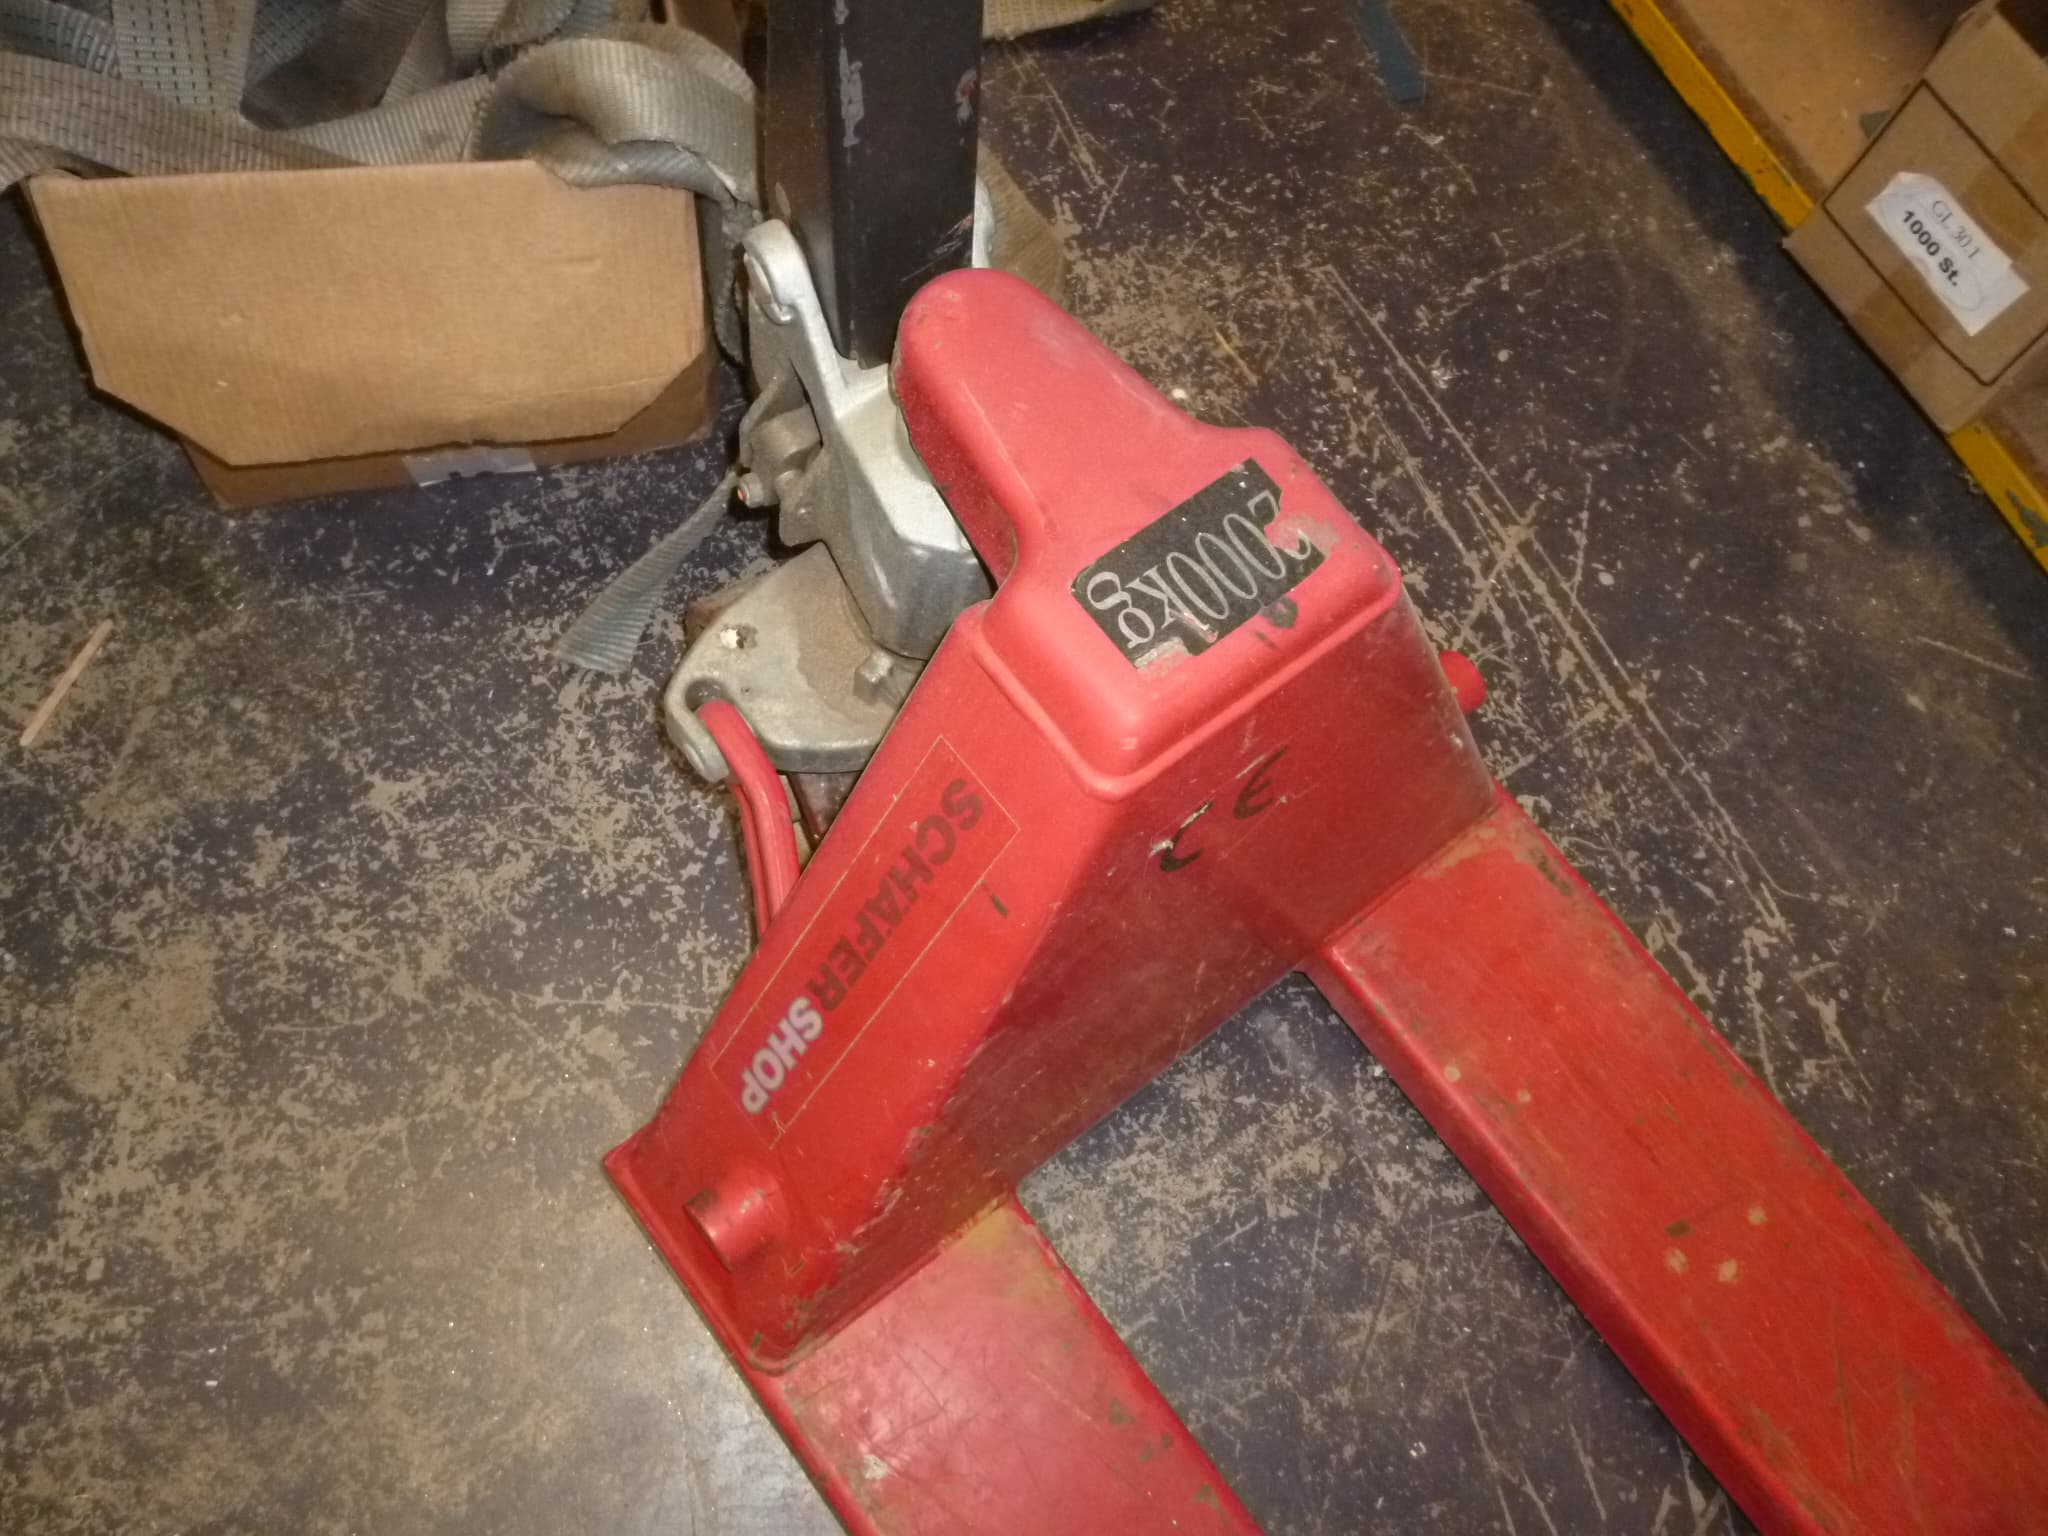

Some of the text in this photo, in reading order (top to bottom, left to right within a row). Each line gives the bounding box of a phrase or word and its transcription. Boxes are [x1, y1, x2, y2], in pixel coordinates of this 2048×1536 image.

[1902, 210, 1959, 287] 1000 St.
[1932, 200, 1953, 228] GL
[740, 995, 823, 1115] SHOP
